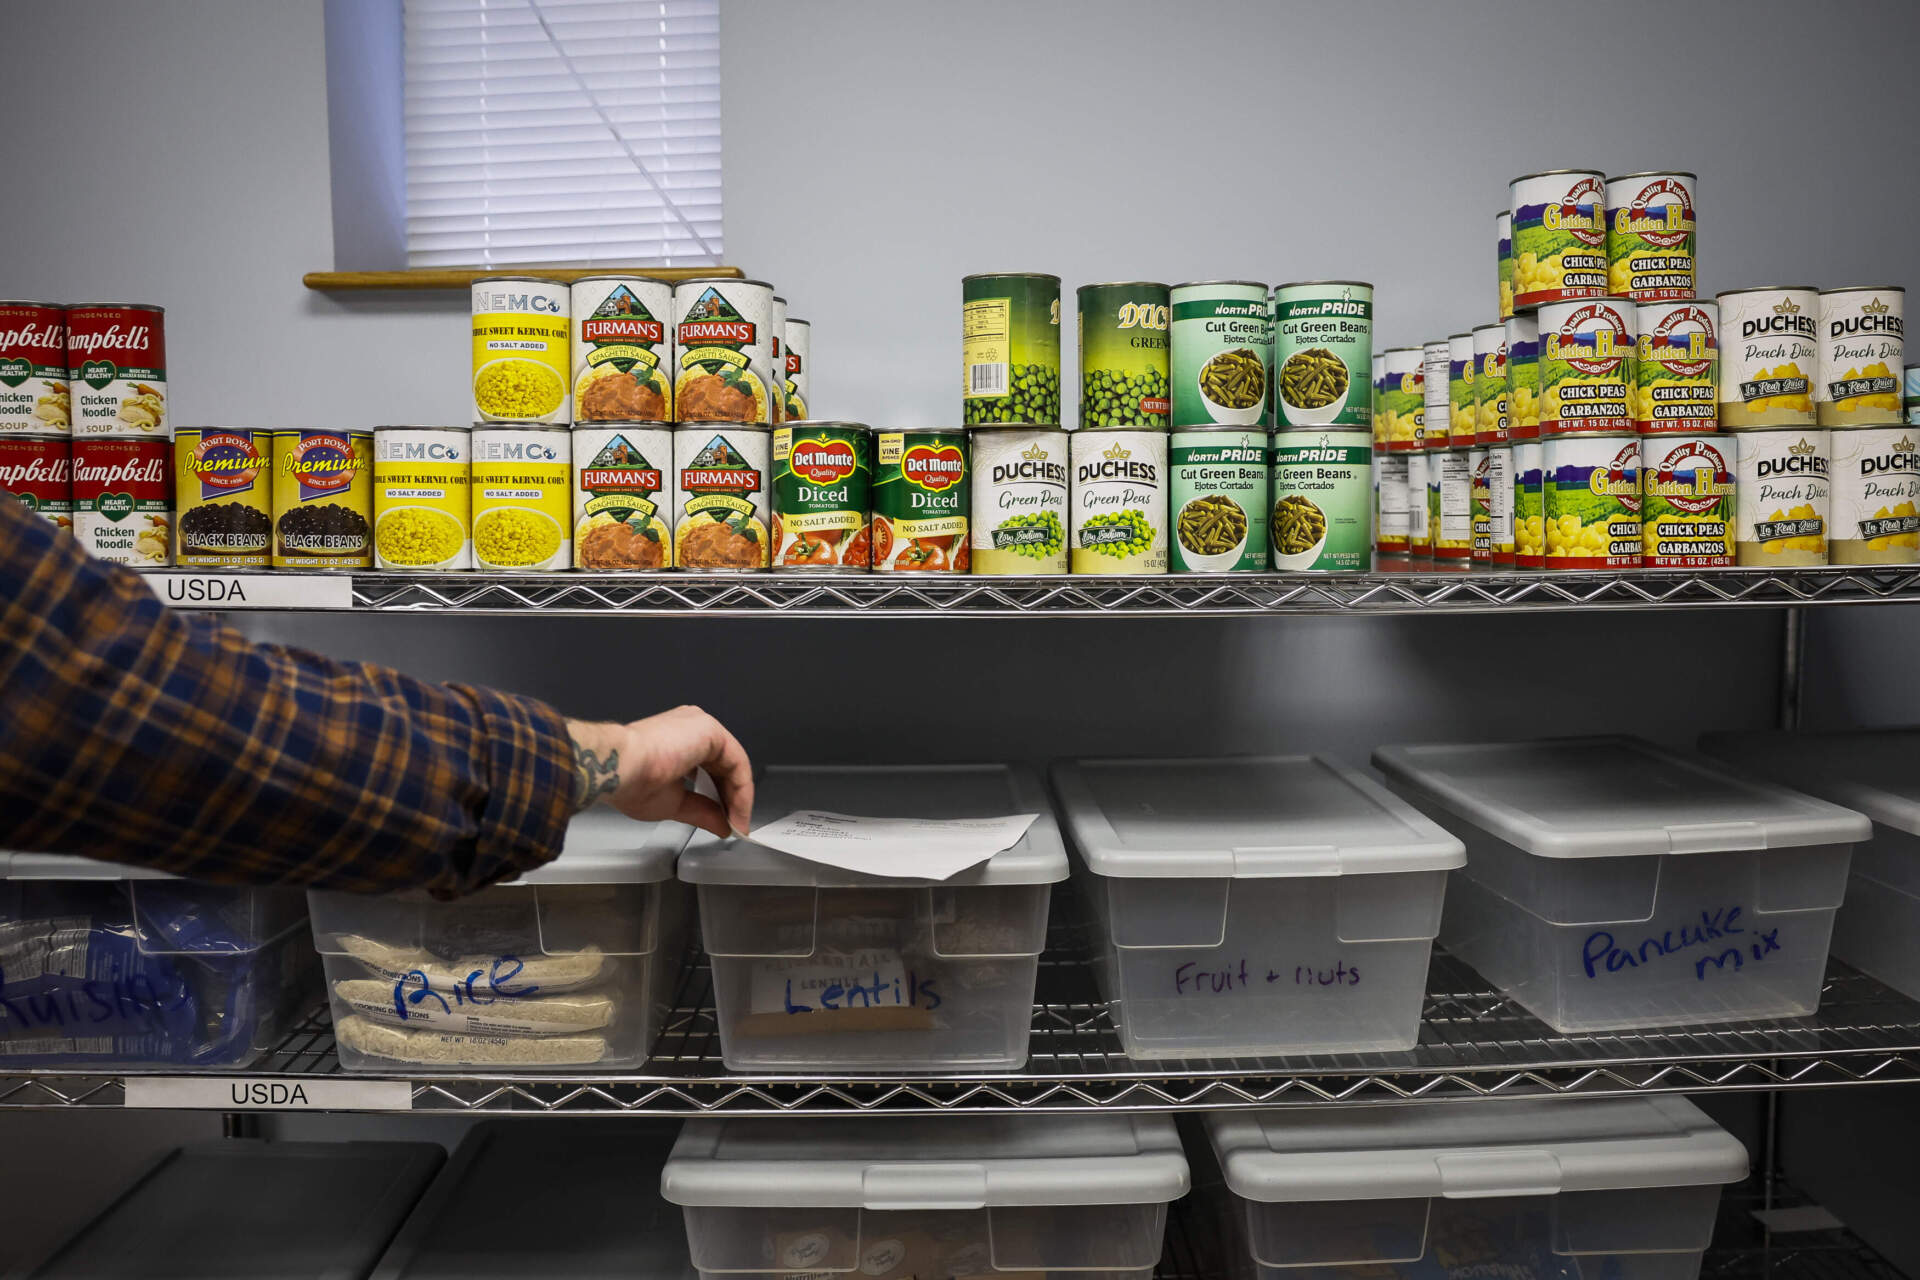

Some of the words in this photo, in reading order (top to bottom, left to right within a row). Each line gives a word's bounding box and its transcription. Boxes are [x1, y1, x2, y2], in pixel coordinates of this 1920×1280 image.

[1630, 257, 1666, 271] CHICK
[1668, 256, 1691, 270] PEAS
[1632, 276, 1692, 288] GARBANZOS
[1289, 304, 1320, 316] NORTH
[1322, 302, 1365, 316] PRIDE
[1282, 322, 1298, 334] Cut
[1300, 322, 1337, 334] Green
[1340, 321, 1367, 334] Beans
[1560, 309, 1590, 336] Quality
[489, 327, 514, 336] SWEET
[517, 326, 550, 336] KERNEL
[552, 329, 568, 339] CORN
[586, 322, 658, 339] FURMAN'S
[680, 324, 749, 340] FURMAN'S
[1296, 335, 1318, 344] Ejotes
[1320, 334, 1356, 344] Cortados
[592, 350, 629, 362] SPAGHETTI
[630, 351, 652, 363] SAUCE
[684, 352, 718, 364] SPAGHETTI
[718, 352, 742, 365] SAUCE
[1746, 344, 1786, 362] Peach
[1834, 344, 1876, 362] Peach
[1560, 386, 1596, 400] CHICK
[1598, 385, 1626, 398] PEAS
[1652, 386, 1690, 400] CHICK
[1692, 386, 1714, 398] PEAS
[1745, 384, 1755, 394] In
[80, 395, 118, 406] Chicken
[82, 407, 116, 417] Noodle
[1560, 403, 1626, 418] GARBANZOS
[1653, 404, 1714, 418] GARBANZOS
[200, 436, 224, 451] PORT
[226, 437, 252, 453] ROYAL
[298, 438, 323, 451] PORT
[324, 438, 350, 454] ROYAL
[794, 452, 814, 466] Del
[814, 452, 852, 466] Monte
[1188, 450, 1219, 462] NORTH
[1220, 449, 1262, 462] PRIDE
[1298, 449, 1348, 462] PRIDE
[1660, 448, 1690, 472] Quality
[183, 451, 270, 476] Premium
[282, 452, 366, 476] Premium
[907, 459, 928, 472] Del
[929, 458, 962, 472] Monte
[810, 468, 836, 478] Quality
[993, 461, 1066, 482] DUCHESS
[1079, 461, 1156, 482] DUCHESS
[1180, 468, 1196, 479] Cut
[1200, 468, 1236, 479] Green
[1239, 468, 1264, 479] Beans
[1283, 468, 1313, 479] Green
[1317, 468, 1352, 479] Beans
[387, 476, 411, 484] SWEET
[414, 476, 448, 484] KERNEL
[450, 476, 467, 484] CORN
[486, 476, 509, 484] SWEET
[512, 476, 546, 484] KERNEL
[547, 476, 564, 484] CORN
[584, 472, 656, 488] FURMAN'S
[684, 472, 755, 488] FURMAN'S
[924, 474, 948, 484] Quality
[1194, 482, 1217, 491] Ejotes
[1220, 481, 1254, 490] Cortados
[1298, 481, 1335, 490] Cortados
[798, 486, 848, 502] Diced
[1760, 485, 1801, 502] Peach
[1864, 482, 1905, 500] Peach
[590, 499, 626, 512] SPAGHETTI
[626, 500, 650, 512] SAUCE
[690, 499, 725, 511] SPAGHETTI
[726, 500, 748, 512] SAUCE
[911, 492, 958, 508] Diced
[999, 490, 1038, 508] Green
[1040, 489, 1063, 507] Peas
[1084, 490, 1121, 508] Green
[1122, 489, 1151, 506] Peas
[790, 519, 804, 527] NO
[805, 518, 826, 526] SALT
[828, 516, 856, 524] ADDED
[902, 524, 916, 532] NO
[917, 523, 940, 532] SALT
[941, 522, 964, 530] ADDED
[94, 528, 134, 537] Chicken
[1658, 523, 1694, 537] CHICK
[1698, 523, 1724, 536] PEAS
[96, 539, 133, 549] Noodle
[188, 534, 224, 548] BLACK
[226, 534, 266, 548] BEANS
[285, 534, 322, 548] BLACK
[325, 534, 362, 548] BEANS
[1658, 541, 1725, 556] GARBANZOS
[168, 579, 246, 601] USDA
[1696, 928, 1781, 980] mix
[1175, 960, 1248, 994] Fruit
[1296, 960, 1360, 986] nuts
[394, 955, 539, 1020] Rice
[784, 971, 942, 1014] Lentils
[232, 1084, 308, 1104] USDA
